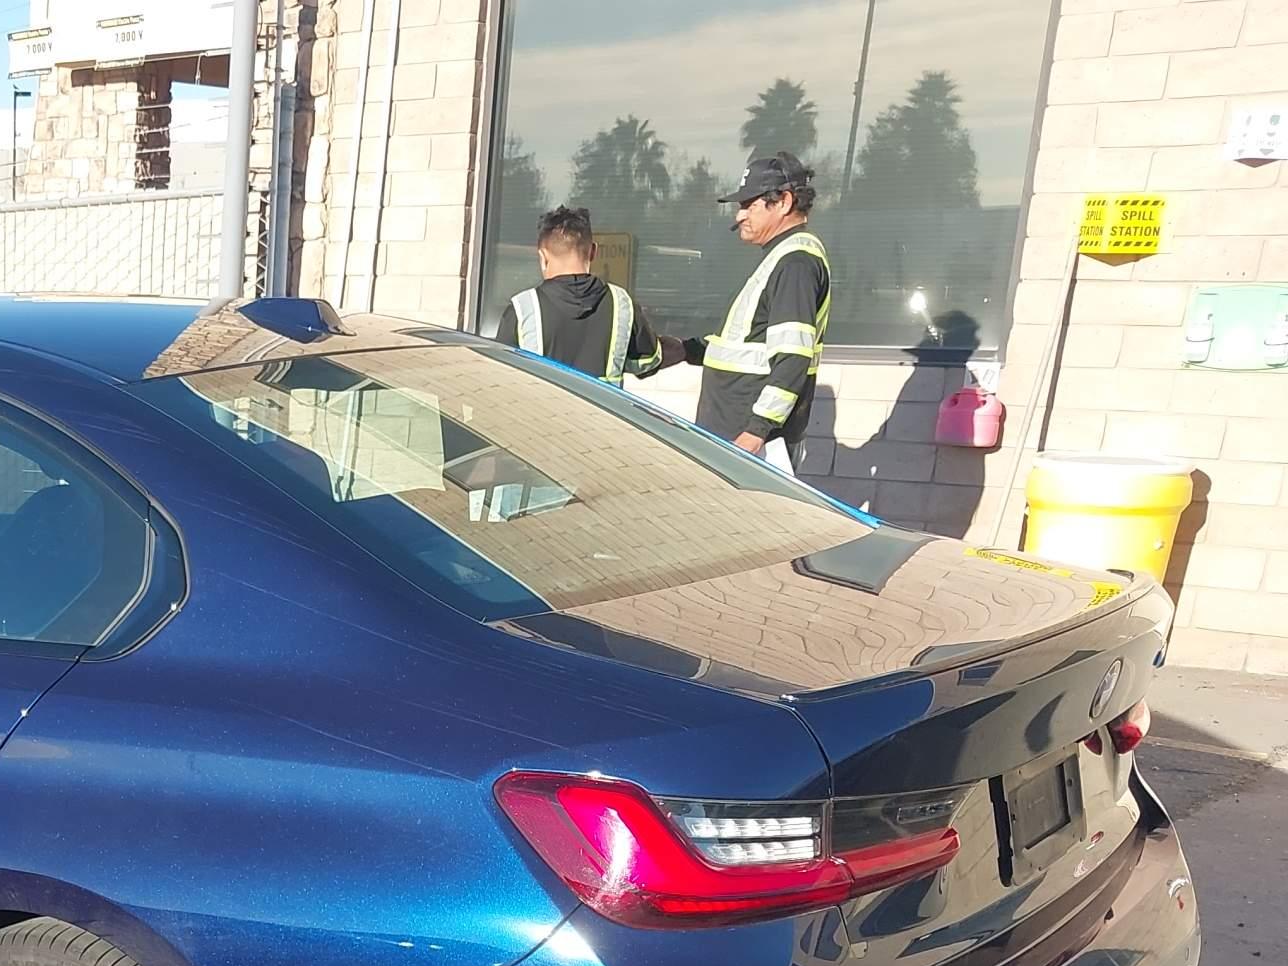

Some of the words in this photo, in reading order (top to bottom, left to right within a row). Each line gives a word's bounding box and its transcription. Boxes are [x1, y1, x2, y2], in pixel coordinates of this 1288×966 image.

[1086, 210, 1102, 221] SPILL
[1121, 210, 1155, 221] SPILL
[1079, 225, 1104, 237] STATION
[1110, 225, 1160, 237] STATION
